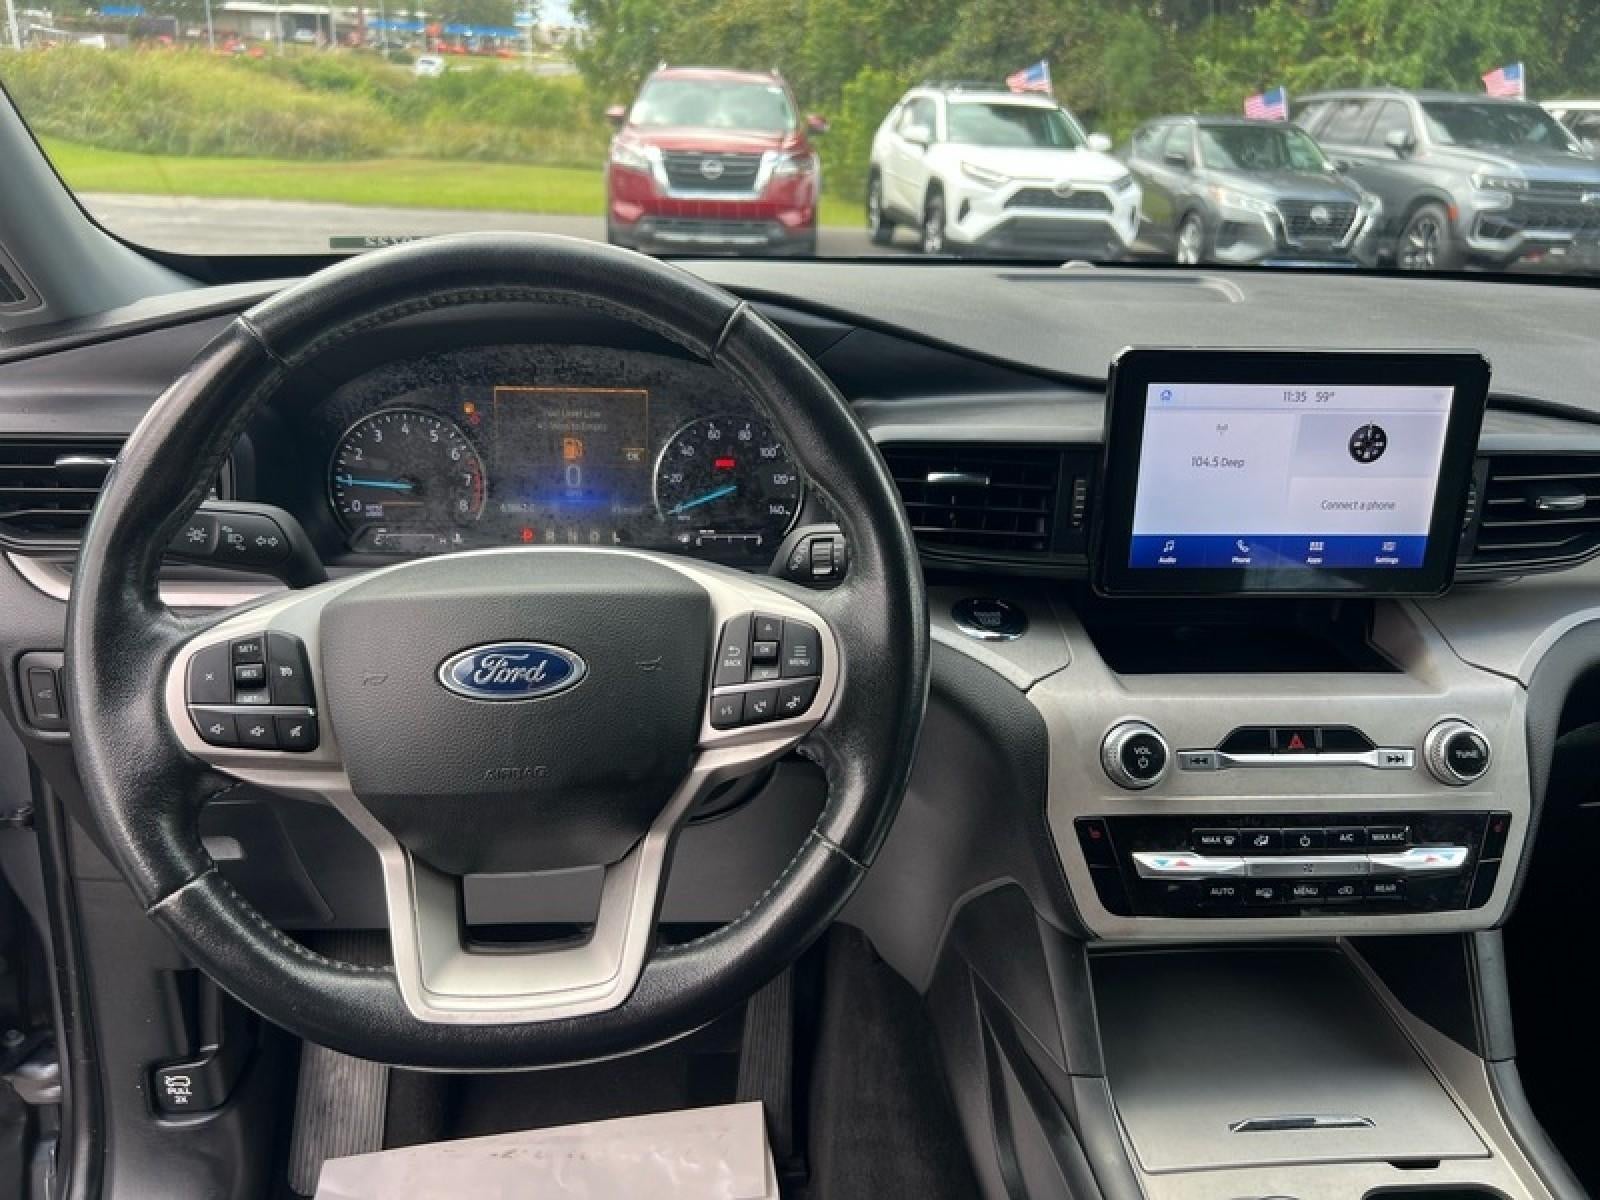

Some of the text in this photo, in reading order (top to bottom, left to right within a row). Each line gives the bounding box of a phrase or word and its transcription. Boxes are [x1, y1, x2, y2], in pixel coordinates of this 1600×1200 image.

[1282, 390, 1307, 402] 11:35
[401, 423, 409, 435] 4
[375, 429, 383, 443] 3
[430, 429, 439, 443] 5
[355, 447, 363, 461] 2
[452, 448, 461, 461] 6
[1191, 456, 1245, 469] 104.5 Deep
[463, 473, 472, 486] 7
[565, 465, 581, 487] 0
[351, 499, 361, 513] 0
[1321, 500, 1395, 512] Connect a phone
[474, 653, 547, 685] Ford
[1133, 745, 1153, 755] VOL
[1339, 833, 1353, 842] A/C
[1210, 886, 1236, 896] AUTO
[1293, 885, 1319, 896] MENU
[167, 1087, 193, 1095] PULL
